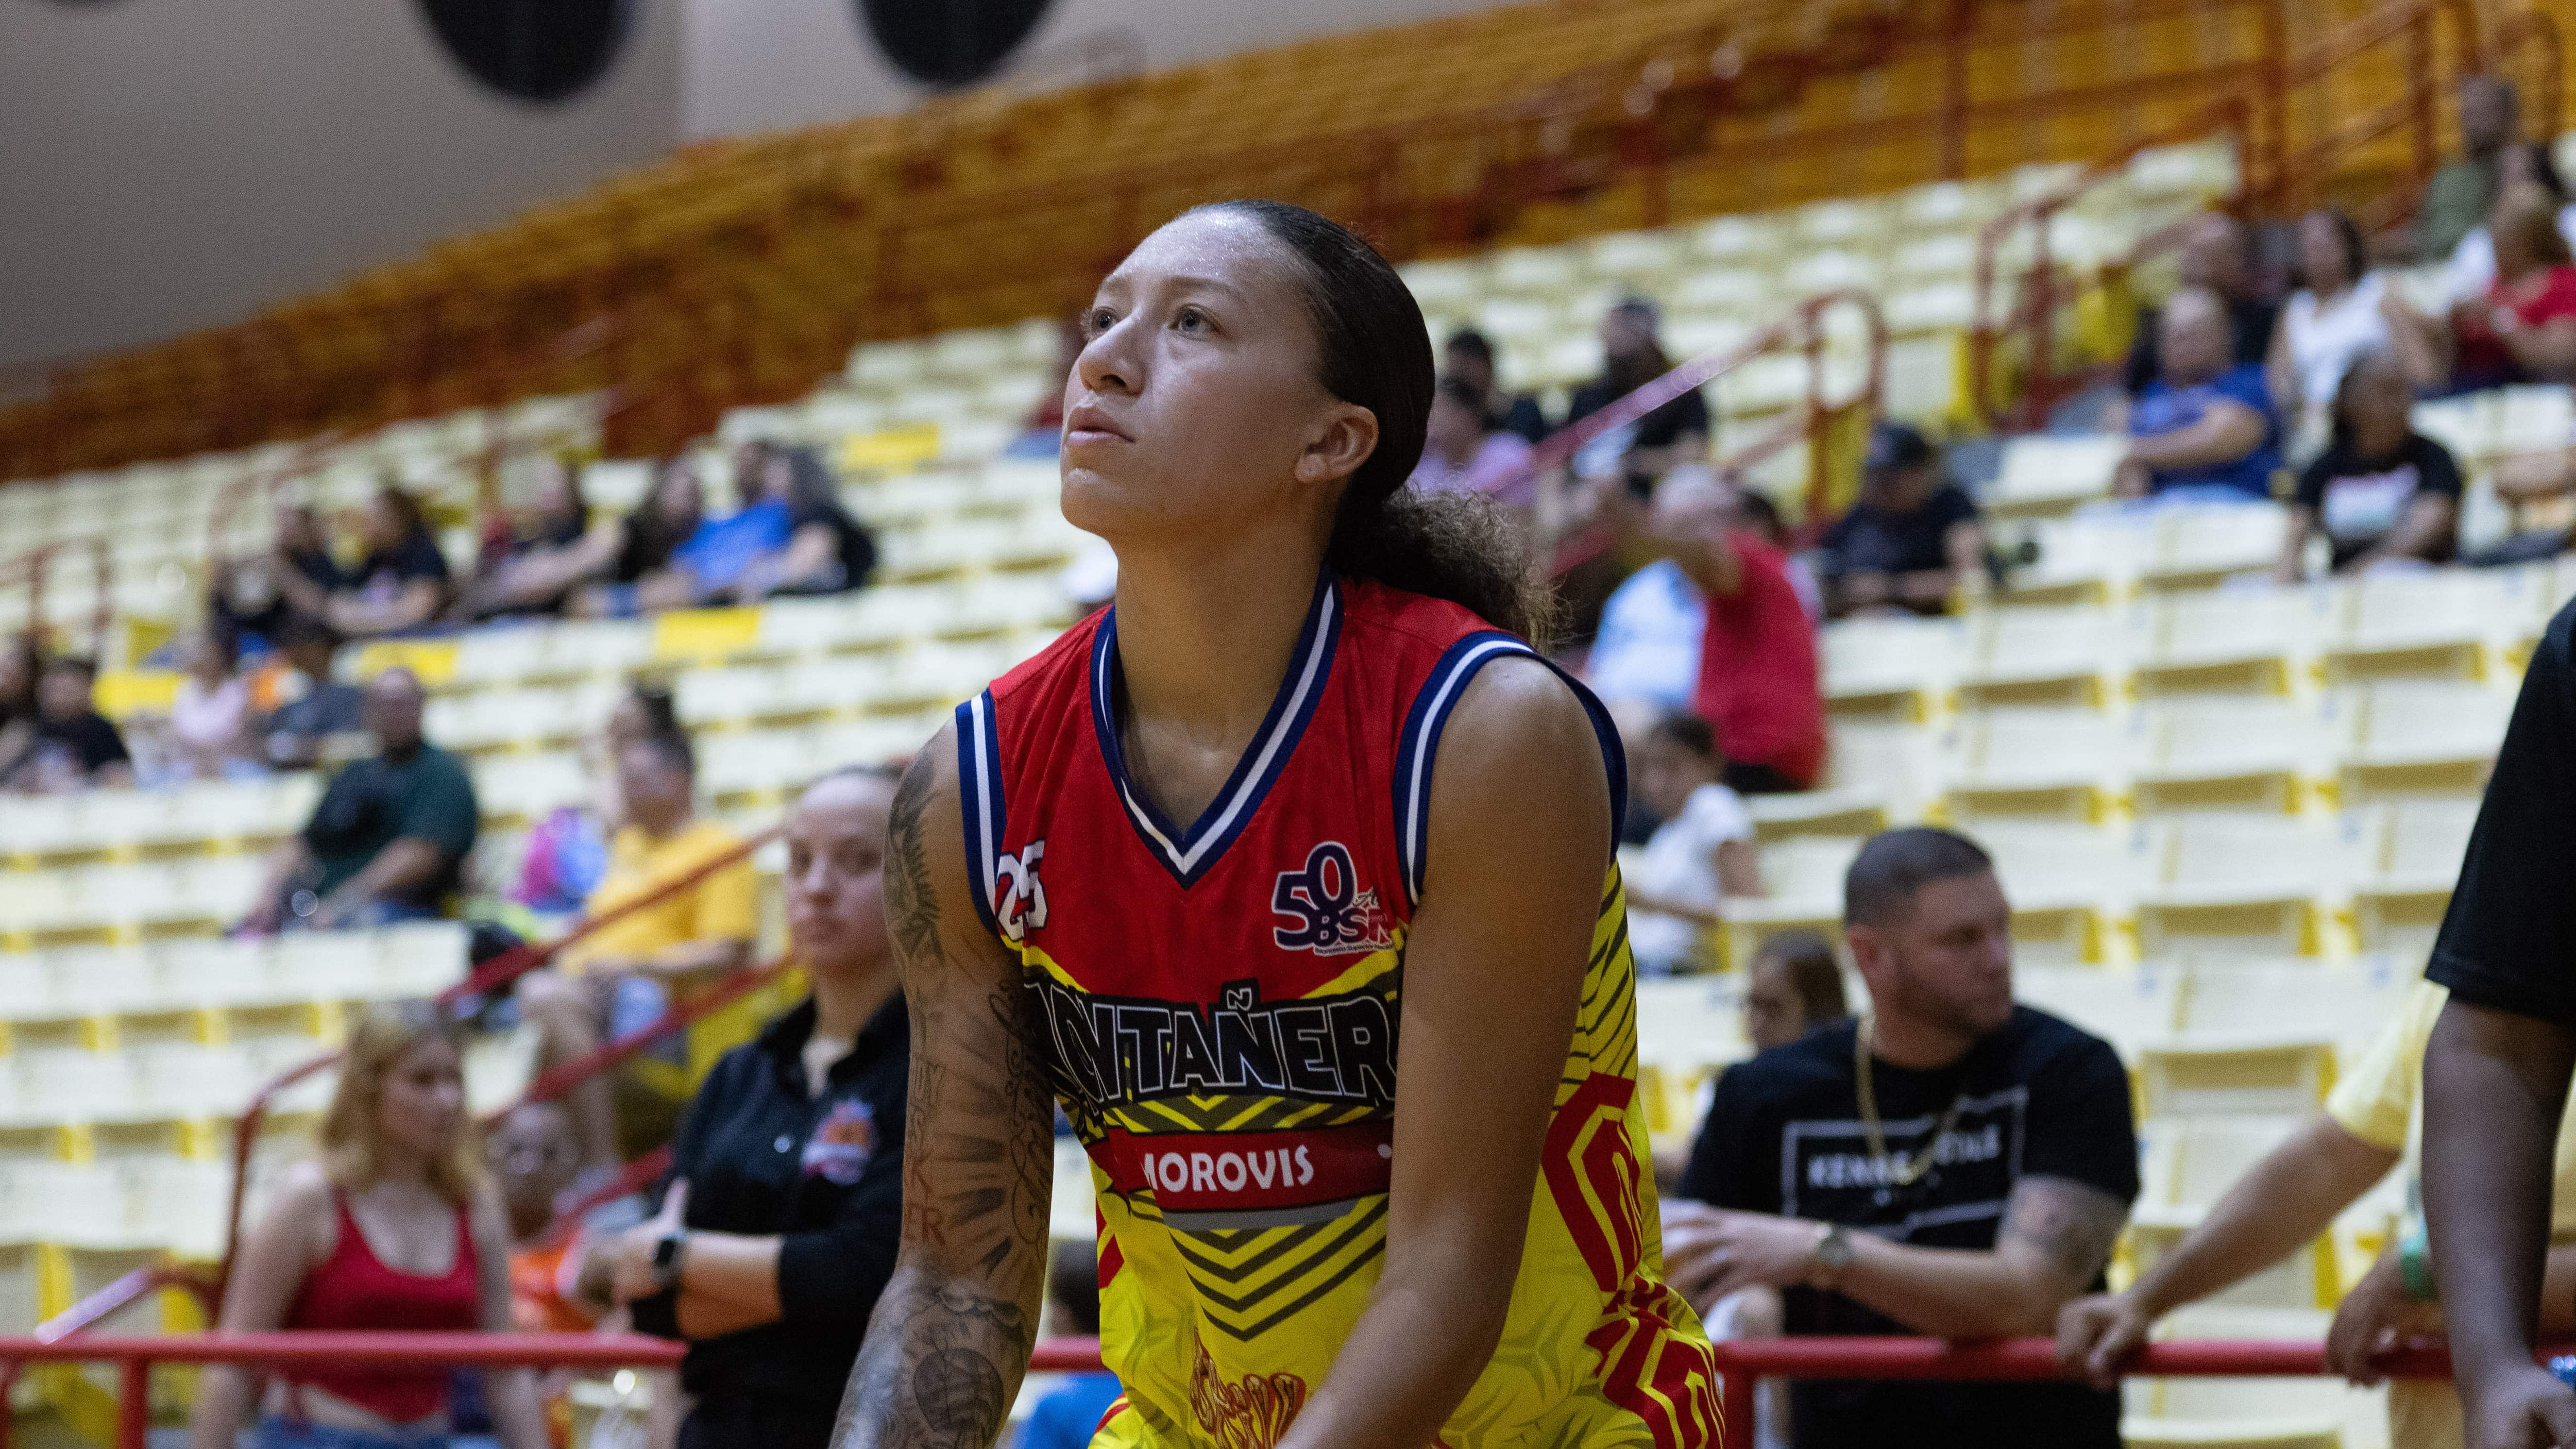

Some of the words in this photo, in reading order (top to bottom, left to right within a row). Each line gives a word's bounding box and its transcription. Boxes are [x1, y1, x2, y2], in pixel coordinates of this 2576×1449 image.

[996, 839, 1048, 941] 25
[1271, 840, 1358, 951] 50
[1024, 982, 1398, 1116] ONTAÑER
